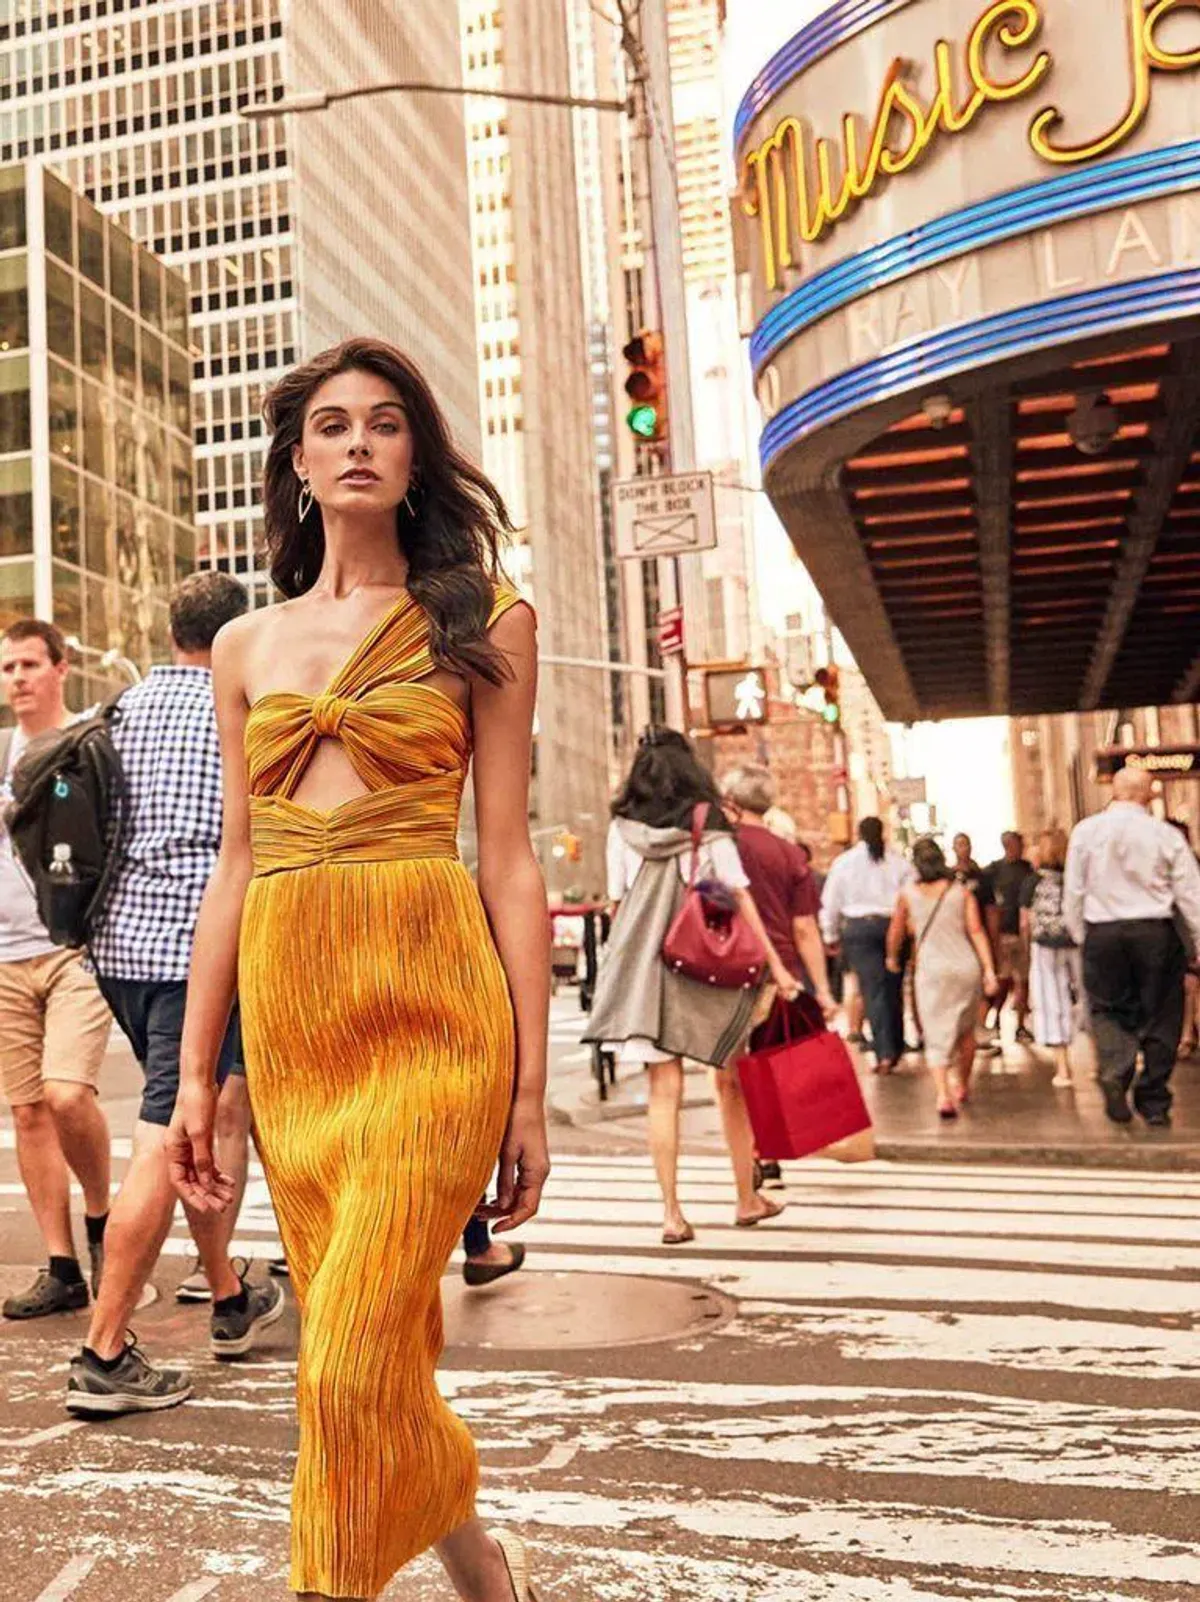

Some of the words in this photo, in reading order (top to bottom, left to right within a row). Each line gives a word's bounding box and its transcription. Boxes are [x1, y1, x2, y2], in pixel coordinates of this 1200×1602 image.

[742, 0, 1048, 290] Music
[850, 258, 968, 362] RAY
[636, 501, 658, 514] THE
[666, 497, 690, 511] BOX
[662, 479, 704, 495] BLOCK
